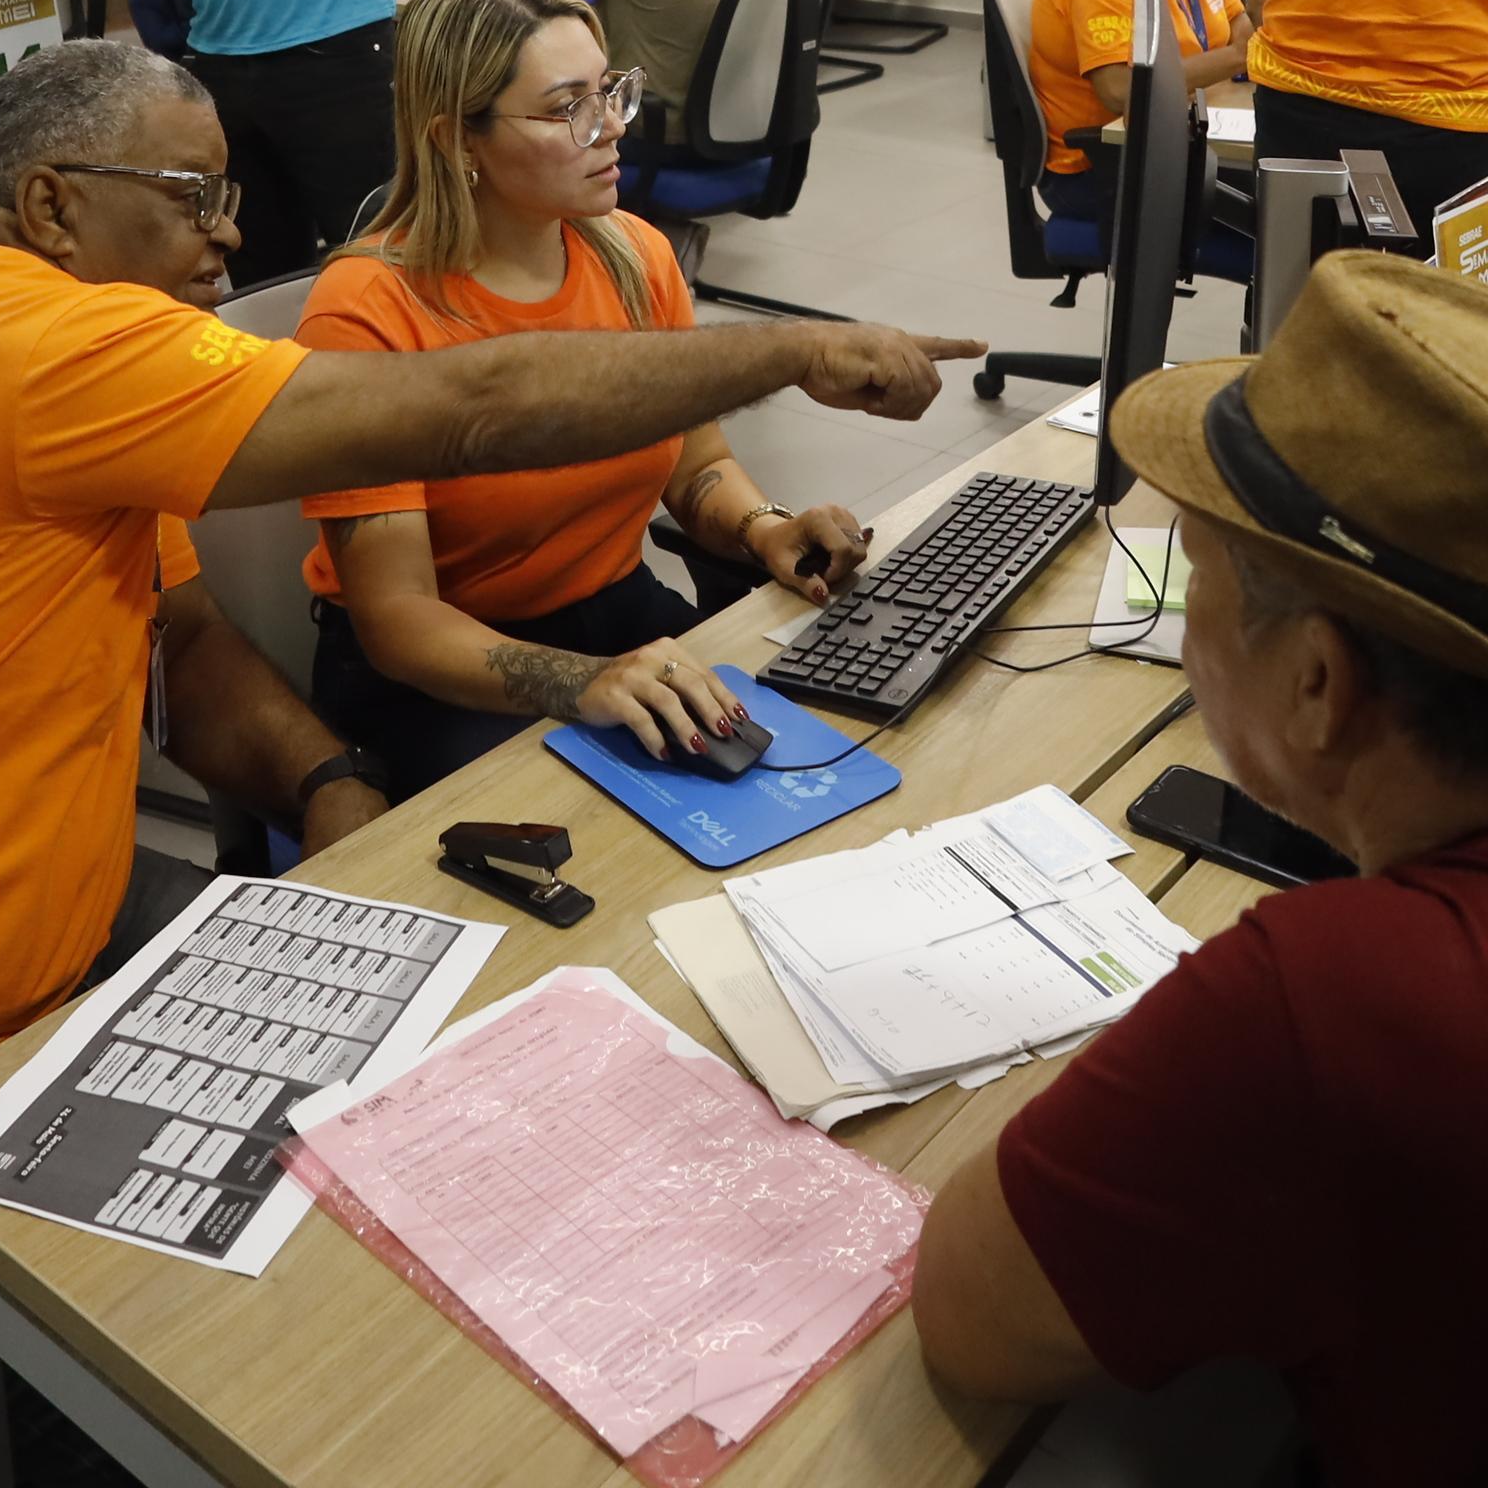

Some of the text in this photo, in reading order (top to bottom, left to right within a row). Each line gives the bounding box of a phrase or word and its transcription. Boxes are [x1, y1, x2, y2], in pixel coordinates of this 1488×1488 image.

[0, 2, 36, 25] MEI
[1087, 15, 1132, 32] SEBRA
[686, 810, 737, 848] DELL
